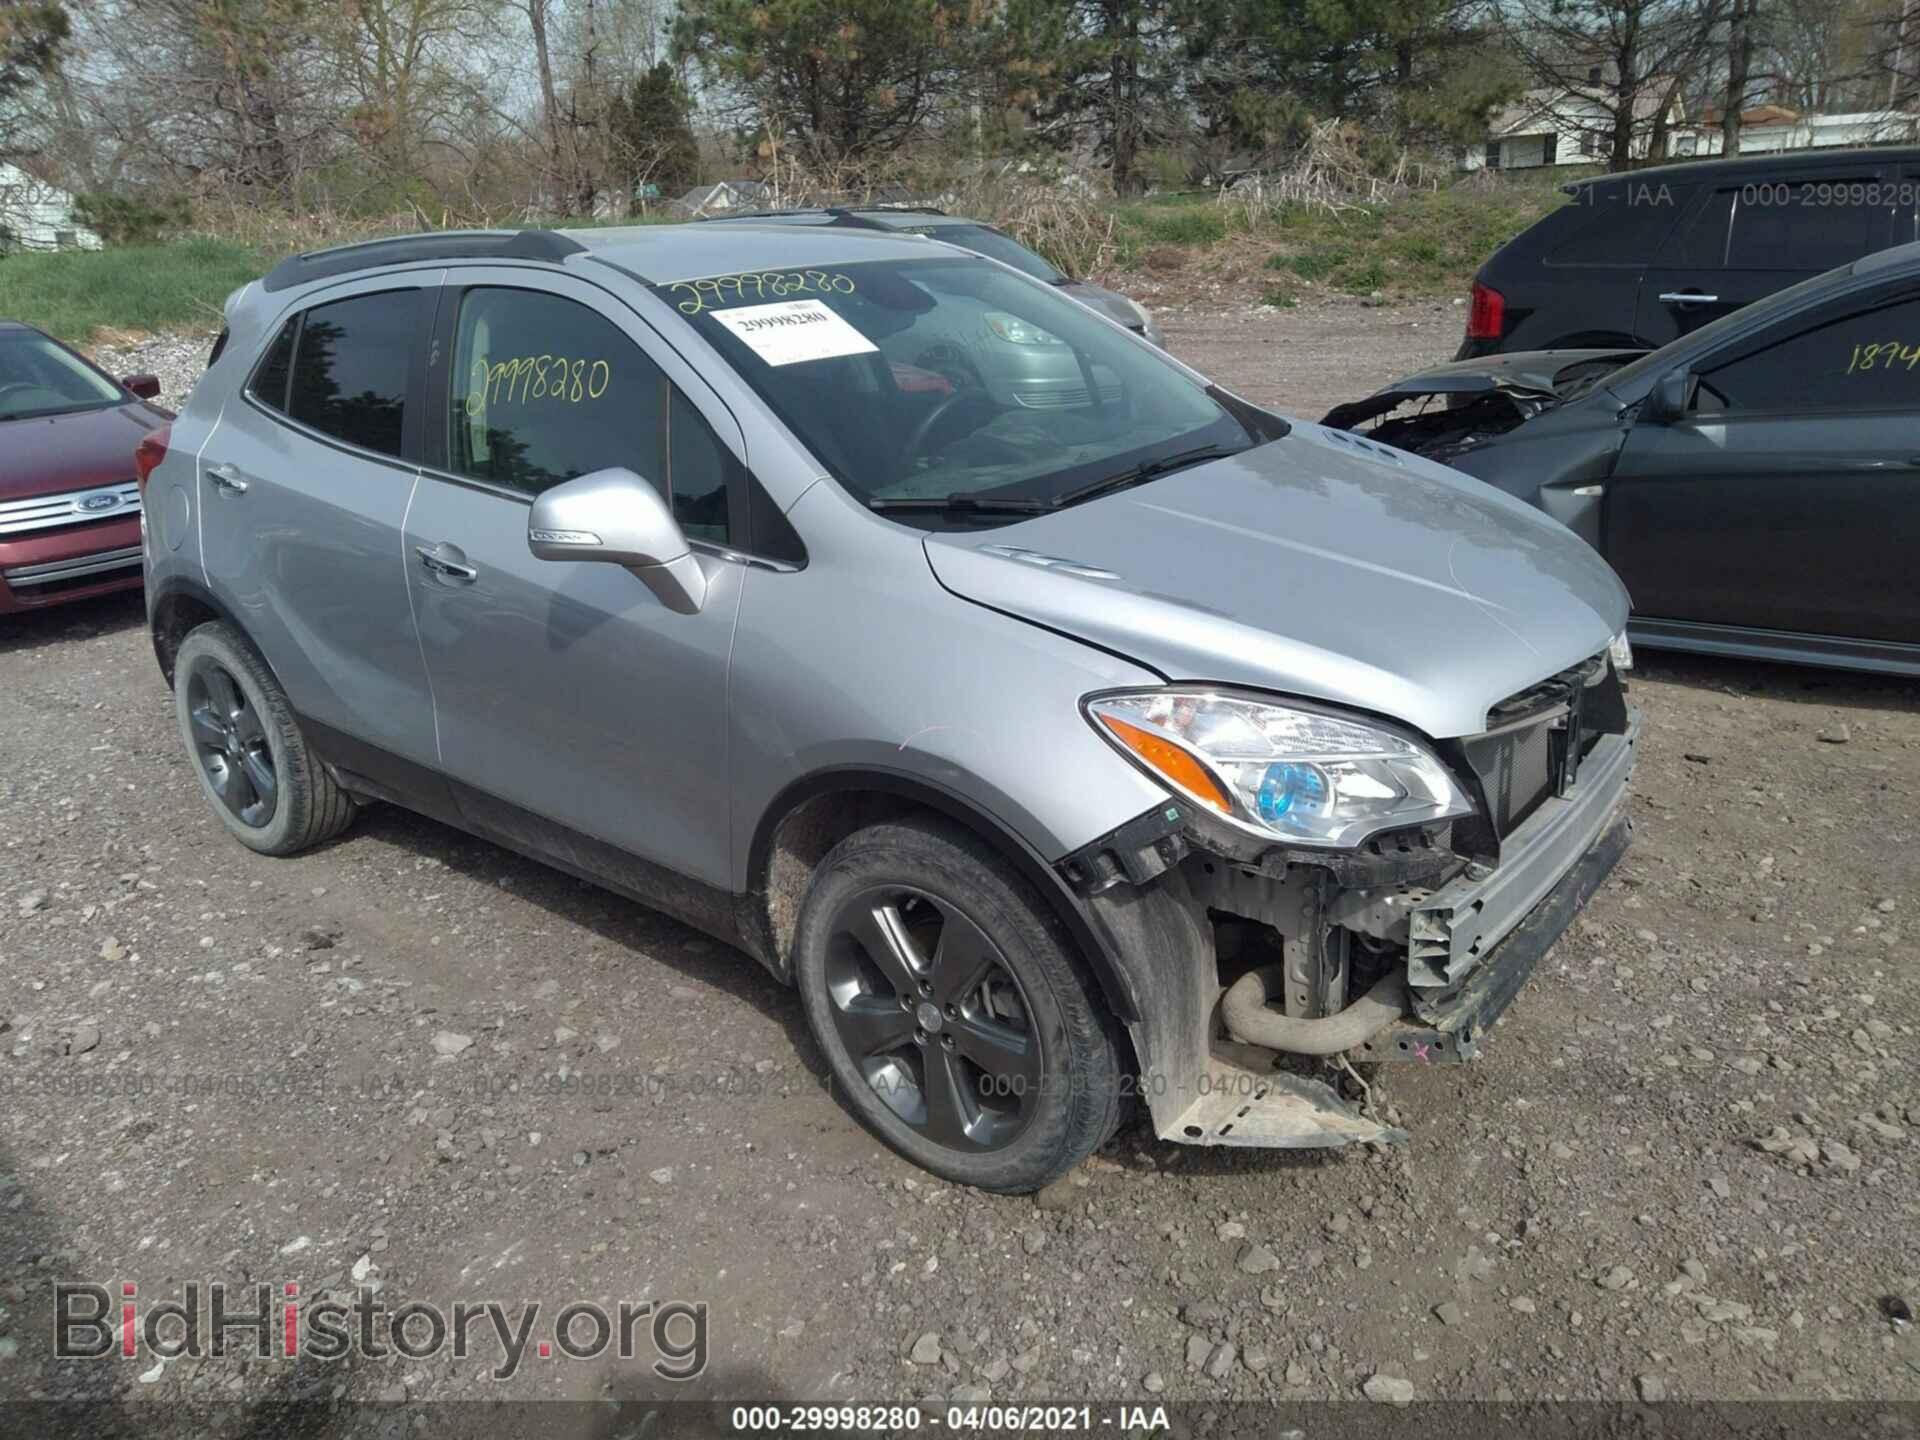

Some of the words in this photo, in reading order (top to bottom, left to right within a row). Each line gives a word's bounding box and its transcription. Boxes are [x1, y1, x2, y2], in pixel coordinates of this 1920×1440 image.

[671, 270, 855, 314] 29998280
[736, 311, 829, 332] 29998280
[465, 355, 609, 416] 29998280
